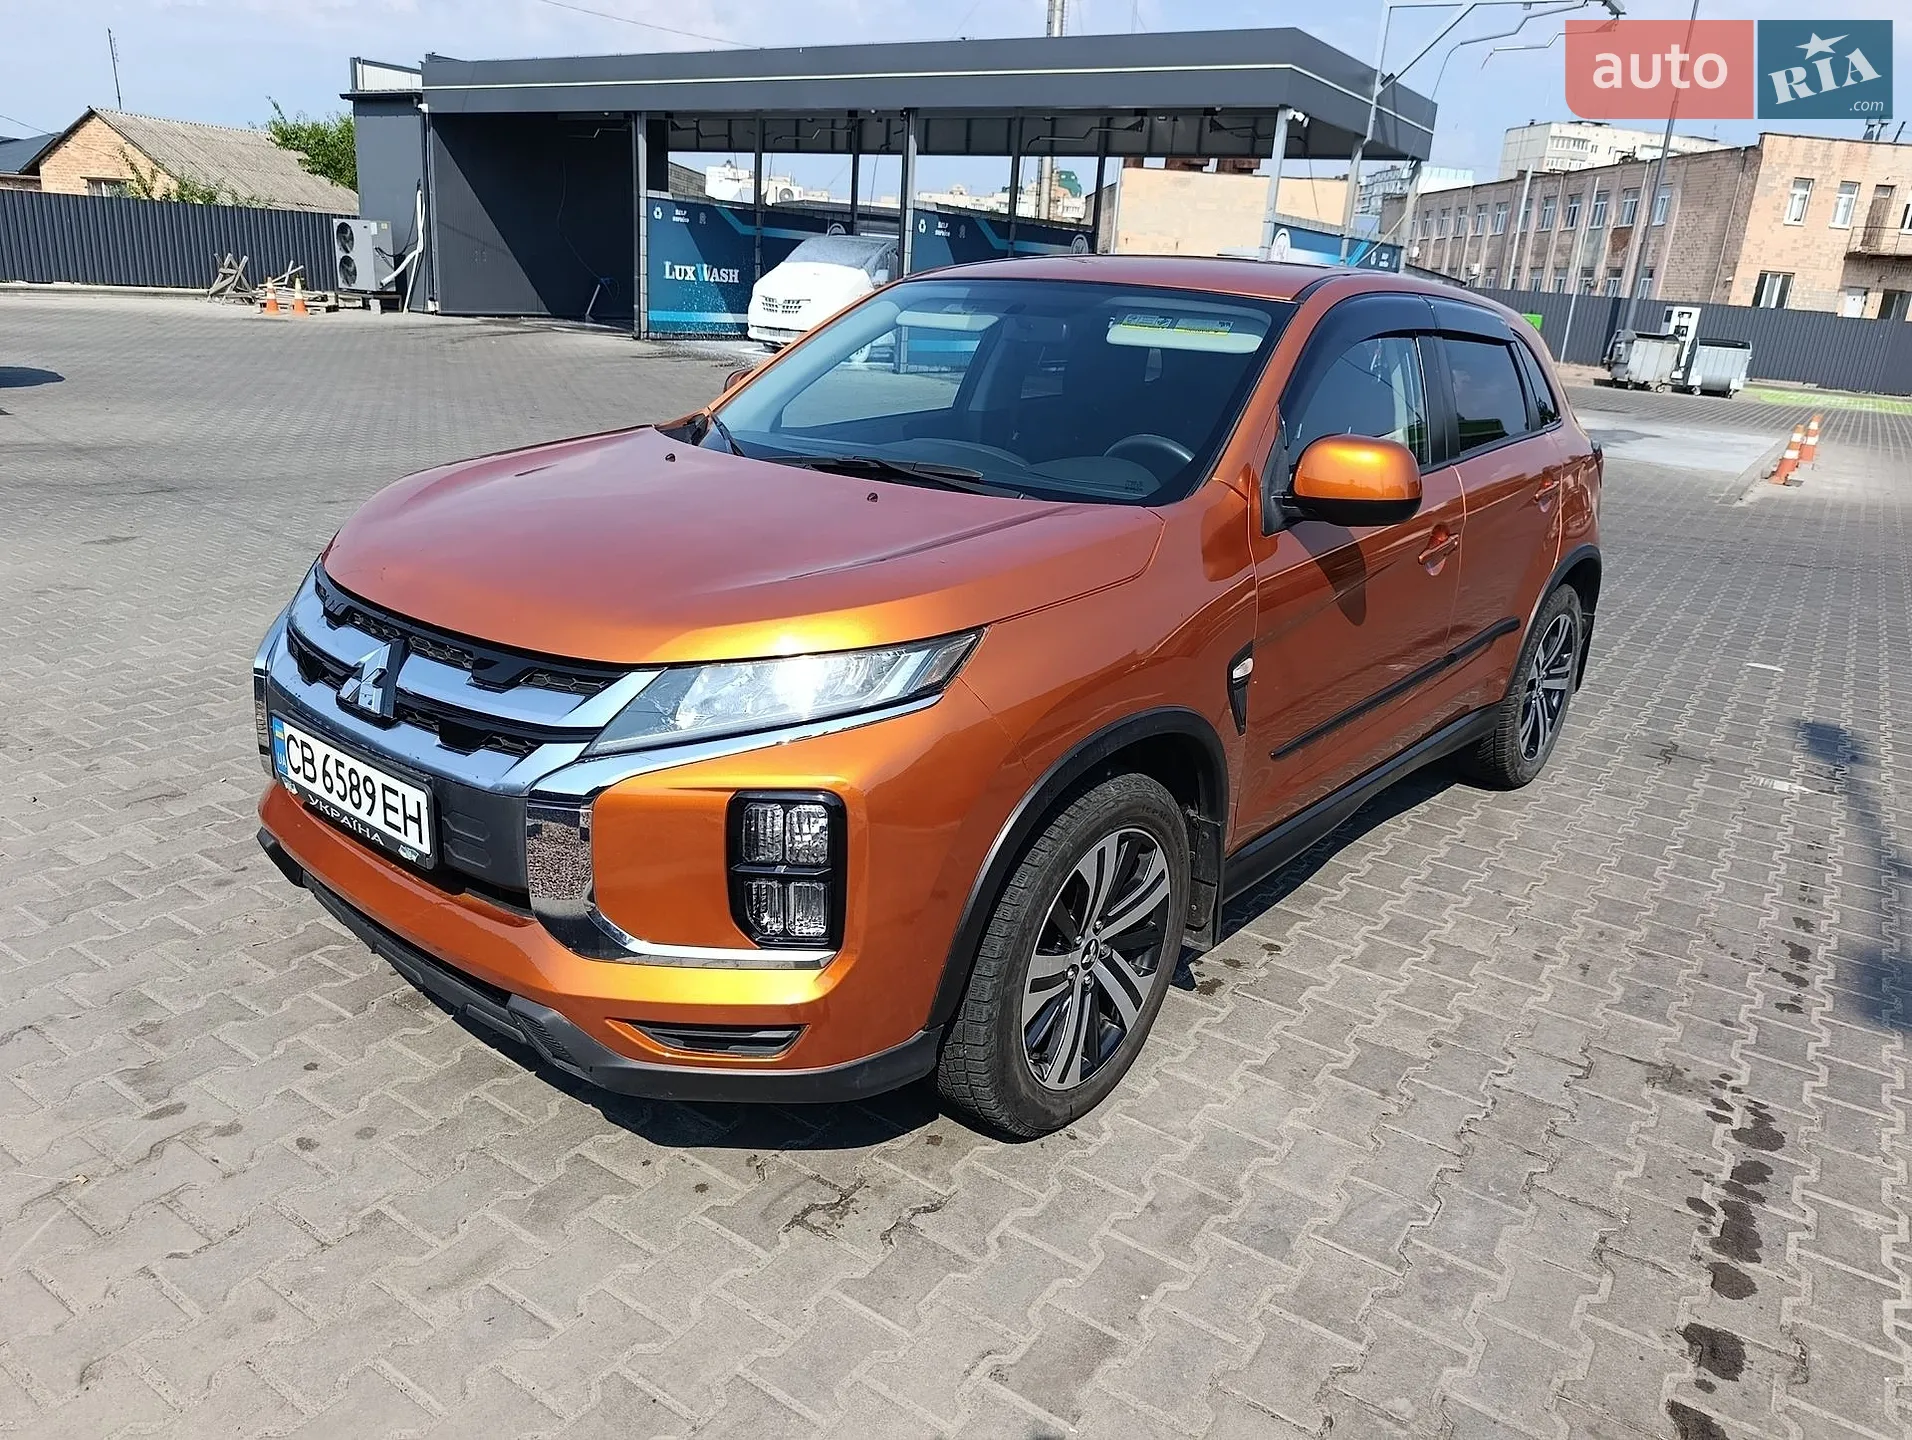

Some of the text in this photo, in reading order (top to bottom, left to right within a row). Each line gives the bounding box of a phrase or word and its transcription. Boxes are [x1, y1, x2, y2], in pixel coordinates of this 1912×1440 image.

[278, 752, 287, 768] UA
[286, 733, 424, 845] CB 6589 EH
[307, 793, 385, 847] УКРАЇНА
